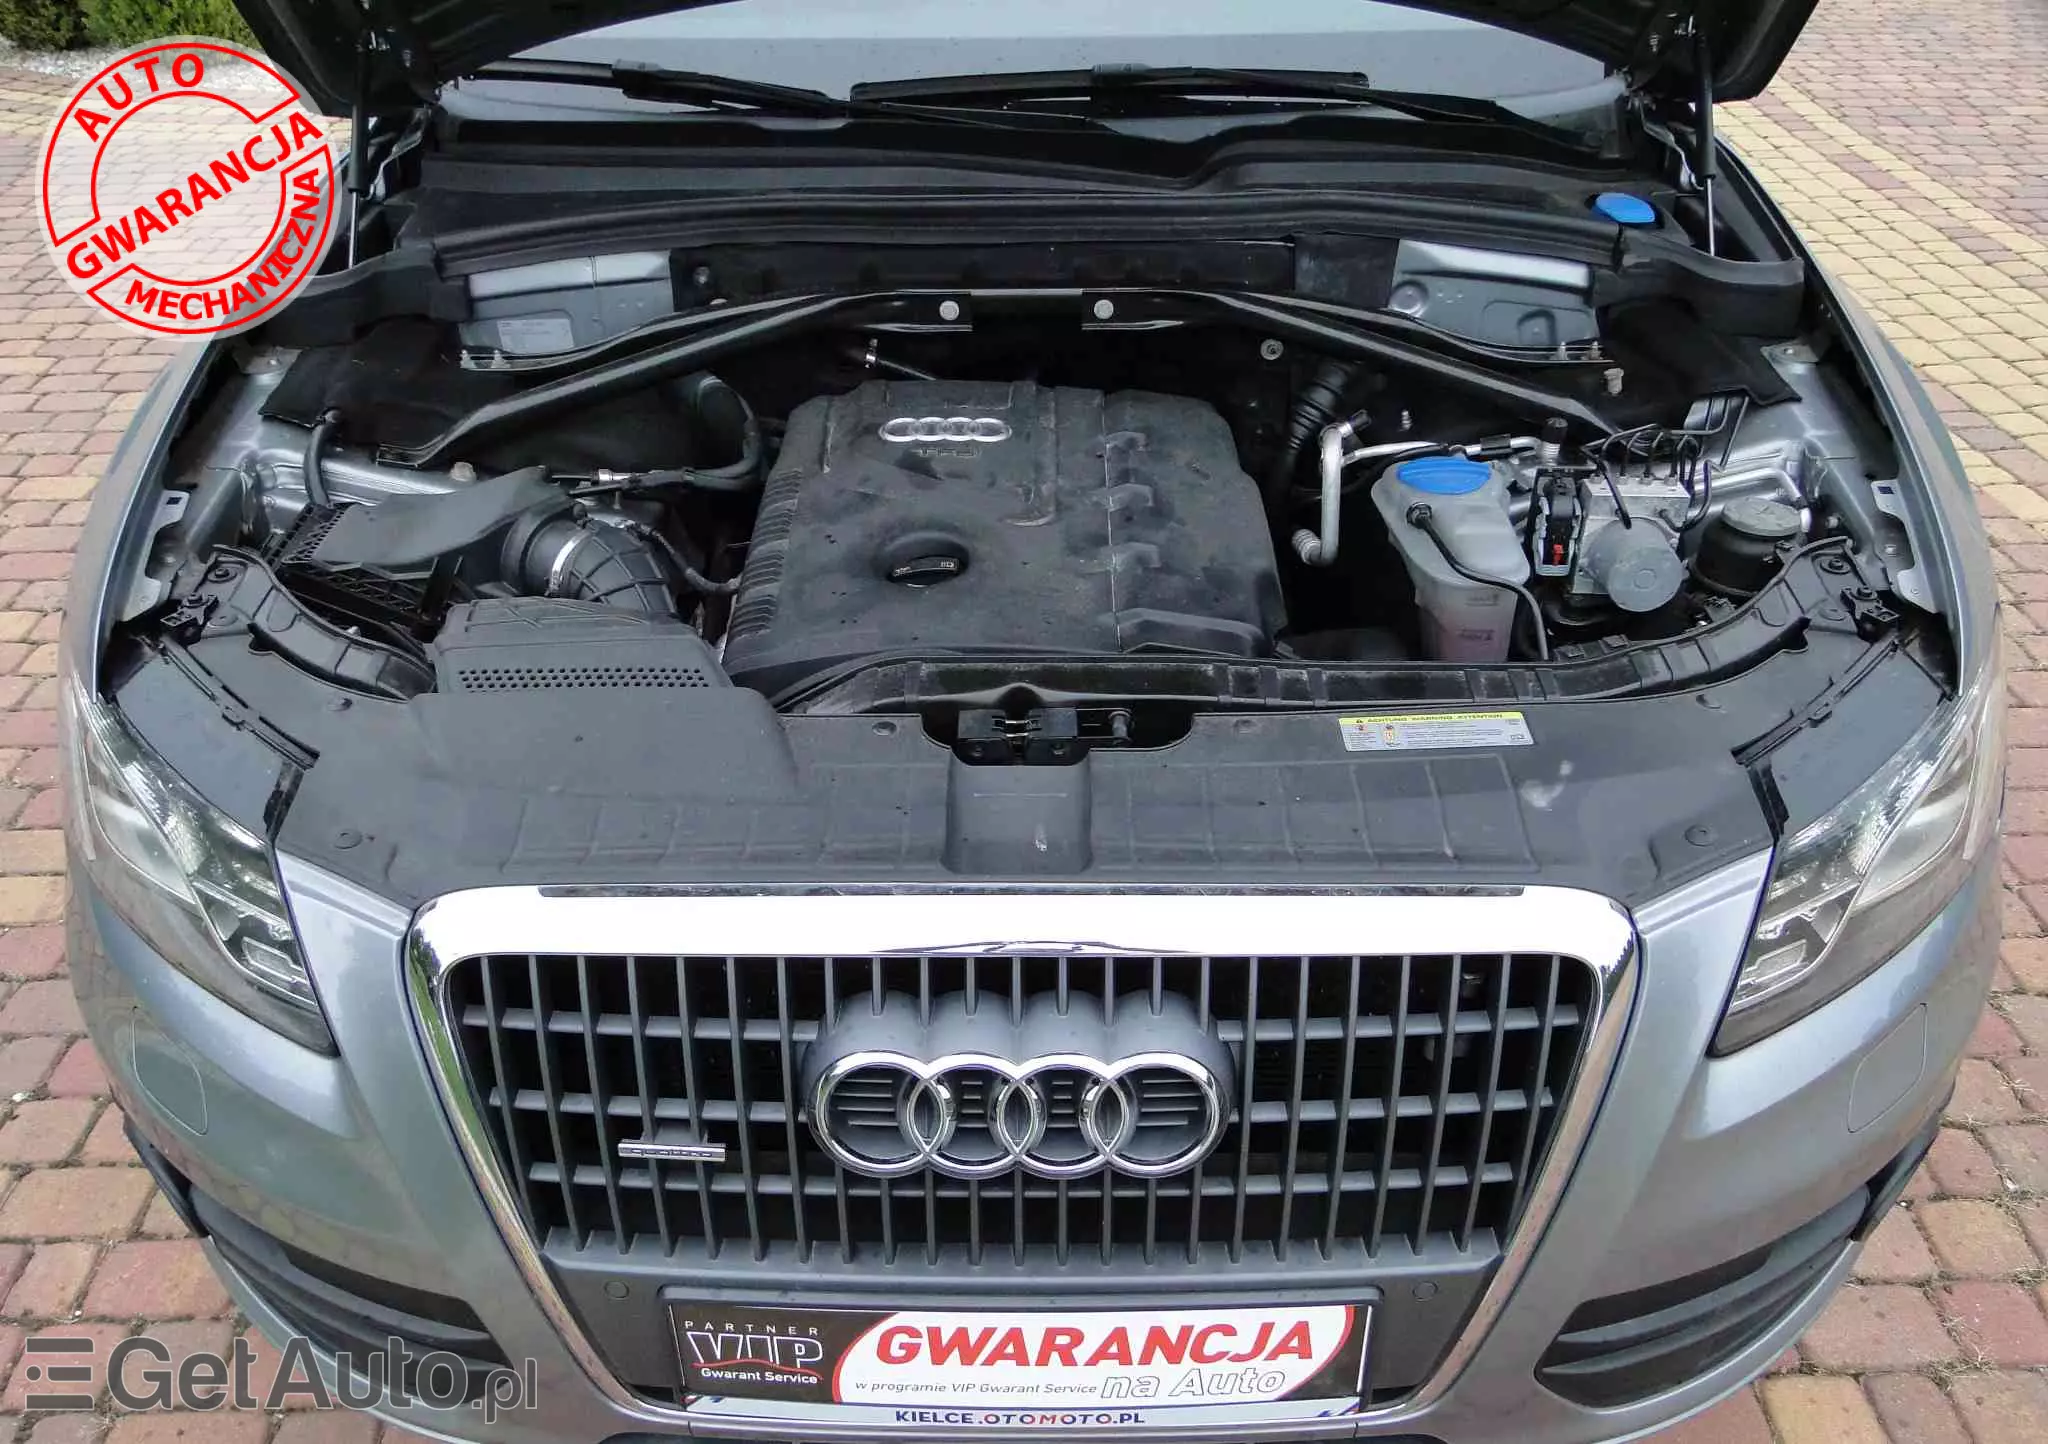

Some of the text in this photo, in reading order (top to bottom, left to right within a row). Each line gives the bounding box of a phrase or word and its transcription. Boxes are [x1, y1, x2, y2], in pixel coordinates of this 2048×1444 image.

[685, 1320, 818, 1337] PARTNER
[686, 1331, 823, 1369] VIP
[876, 1321, 1313, 1367] GWARANCJA
[701, 1367, 818, 1385] Gwarant Service
[855, 1381, 1098, 1394] w programie VIP Gwarant Service
[1100, 1367, 1286, 1399] na Auto
